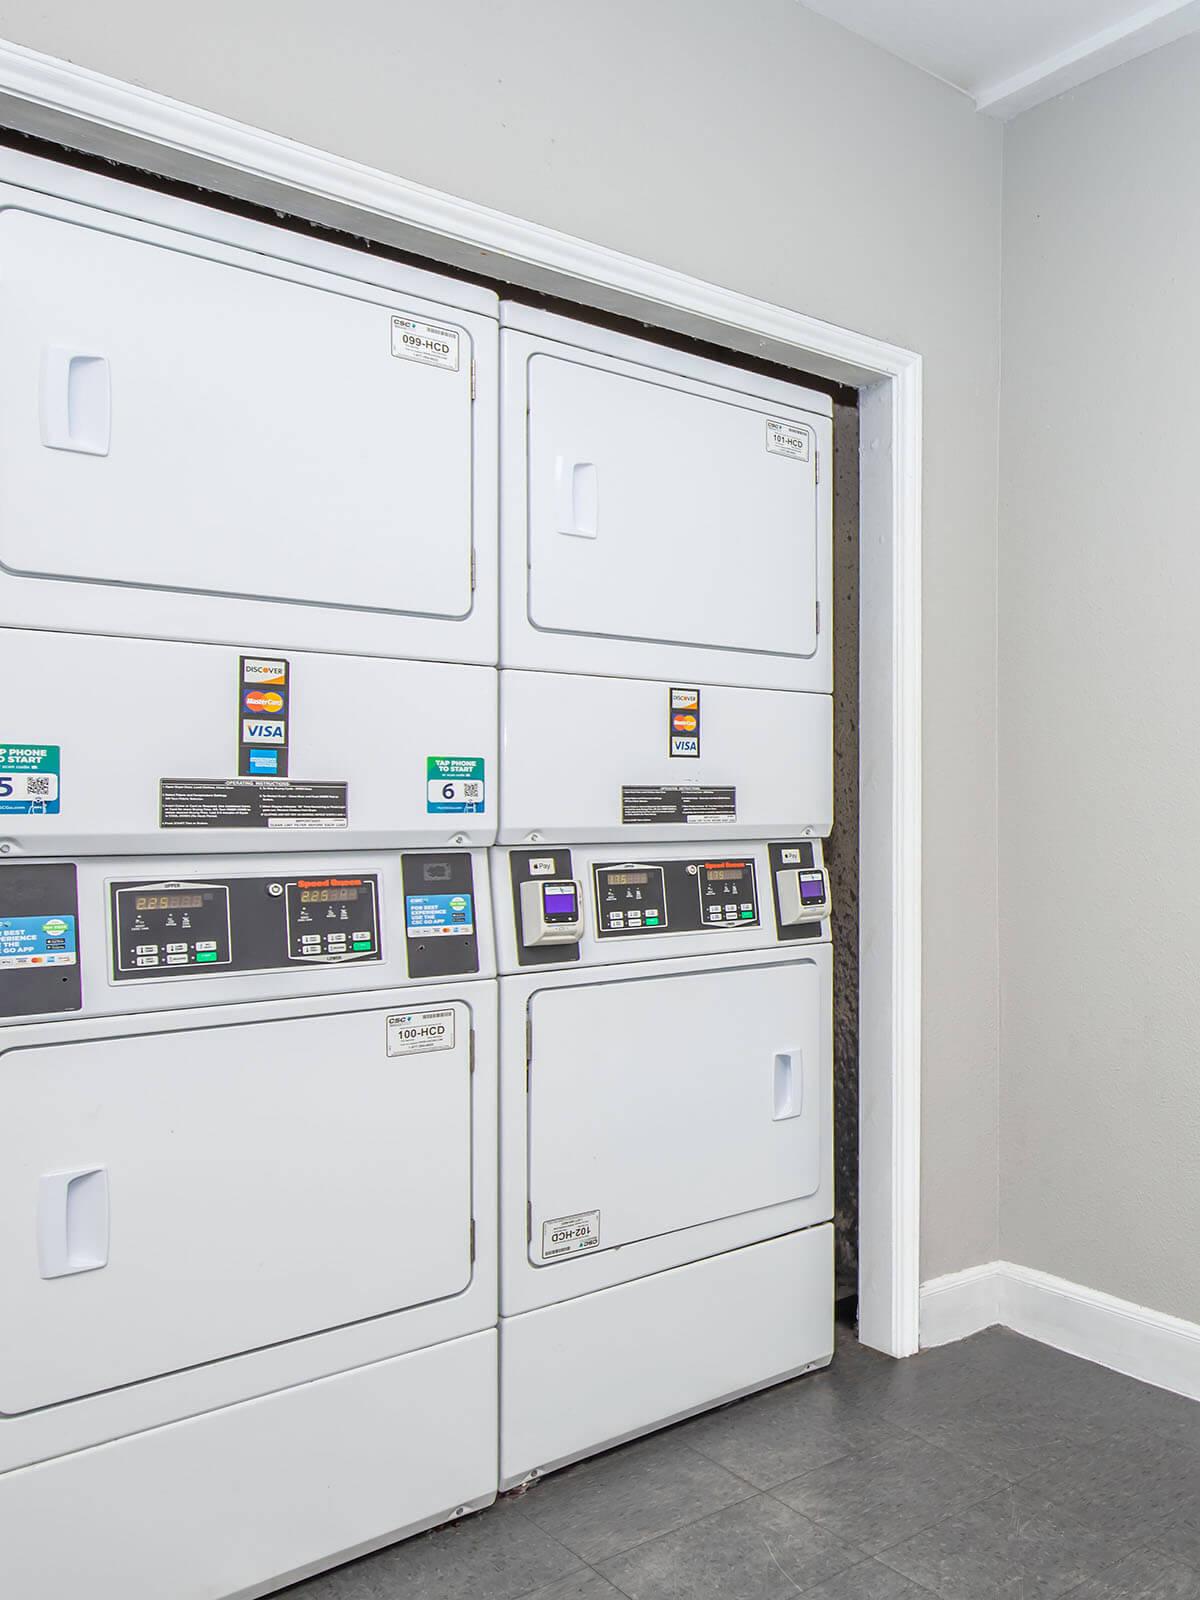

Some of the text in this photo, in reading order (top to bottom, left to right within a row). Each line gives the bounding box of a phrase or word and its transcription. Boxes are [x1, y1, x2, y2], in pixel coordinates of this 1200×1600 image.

[402, 334, 450, 354] 099-HCD
[773, 434, 803, 449] 101-HCD
[248, 725, 283, 738] VISA
[9, 749, 48, 757] PHONE
[675, 741, 696, 751] VISA
[0, 777, 13, 797] 5
[442, 783, 455, 800] 6
[298, 880, 330, 888] Speed
[398, 1024, 446, 1040] 100-HCD
[551, 1226, 592, 1242] 102-HCD
